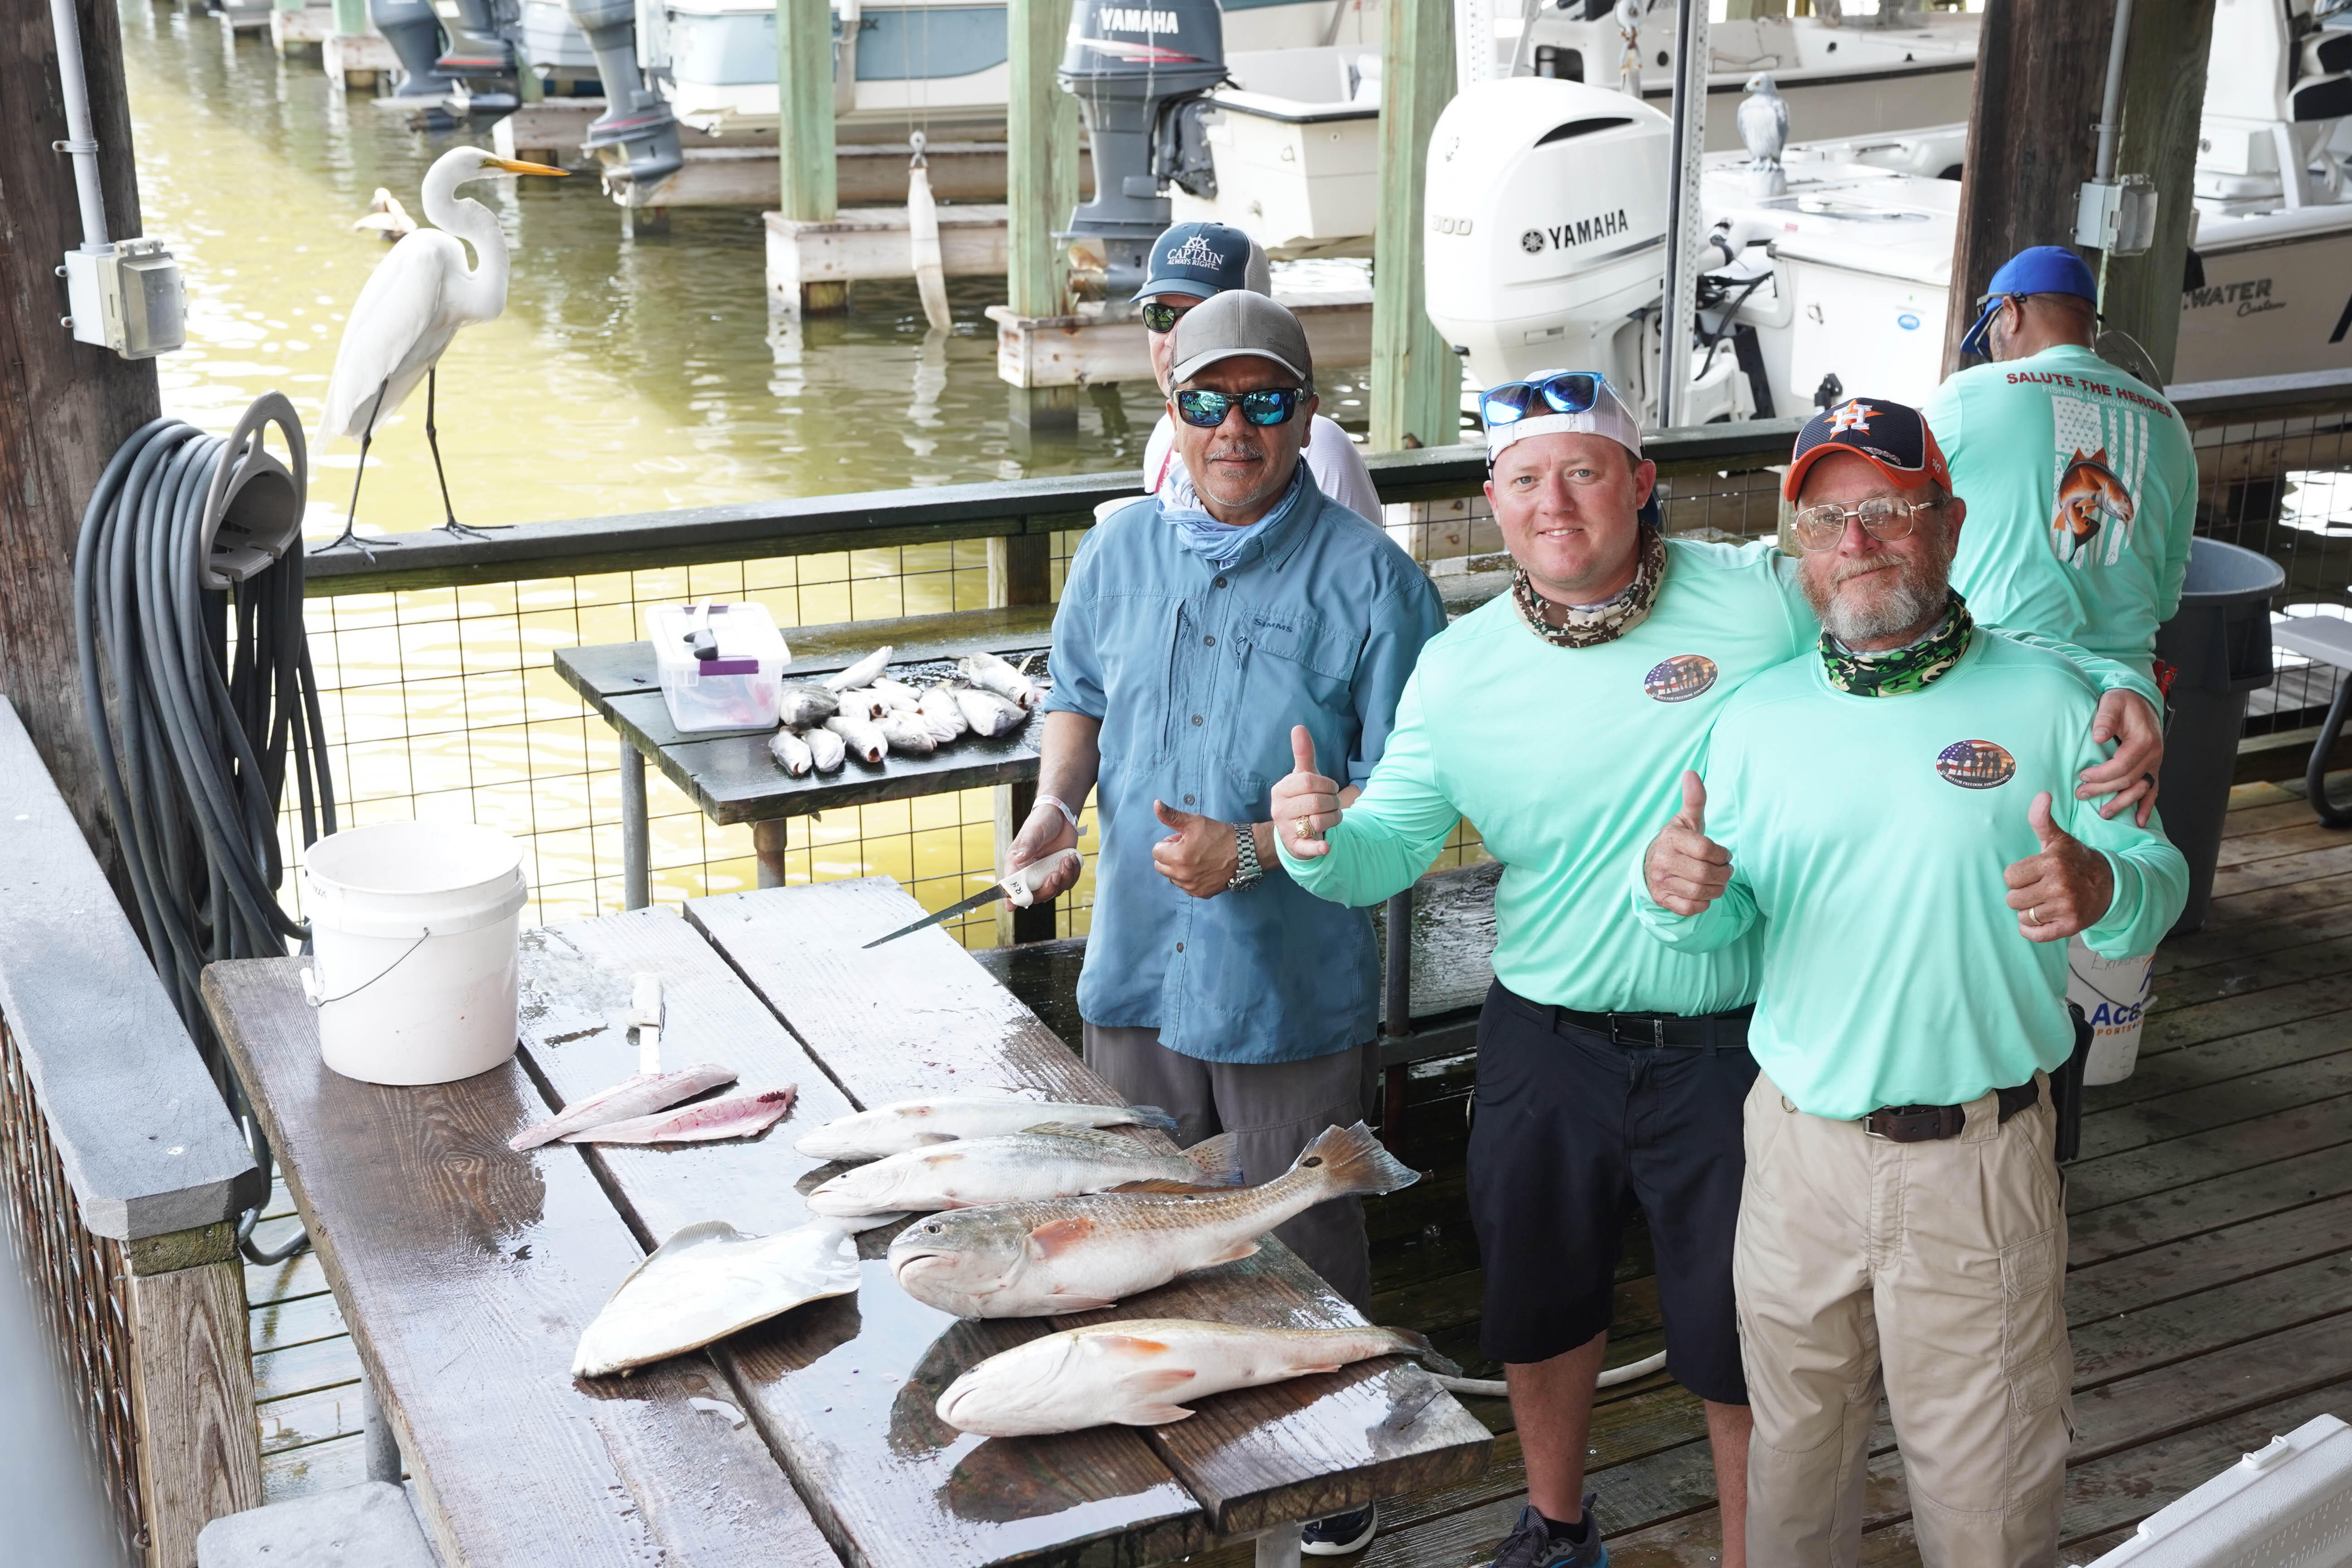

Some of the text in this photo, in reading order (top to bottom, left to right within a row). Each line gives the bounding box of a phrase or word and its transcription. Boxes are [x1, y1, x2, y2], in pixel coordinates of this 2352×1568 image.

[1099, 8, 1179, 34] YAMAHA
[1548, 209, 1629, 250] YAMAHA
[1167, 248, 1224, 265] CAPTAIN
[2183, 279, 2272, 310] WATER
[2006, 372, 2173, 419] SALUTE THE HEROES
[2042, 385, 2151, 416] FISHING TOURNAMENT
[1830, 404, 1873, 434] H
[1253, 618, 1293, 633] SIMMS
[1652, 692, 1666, 700] HEROES
[1693, 677, 1715, 695] FOUNDATION
[1941, 769, 1954, 782] HEROES
[1984, 774, 2010, 787] FOUNDATION
